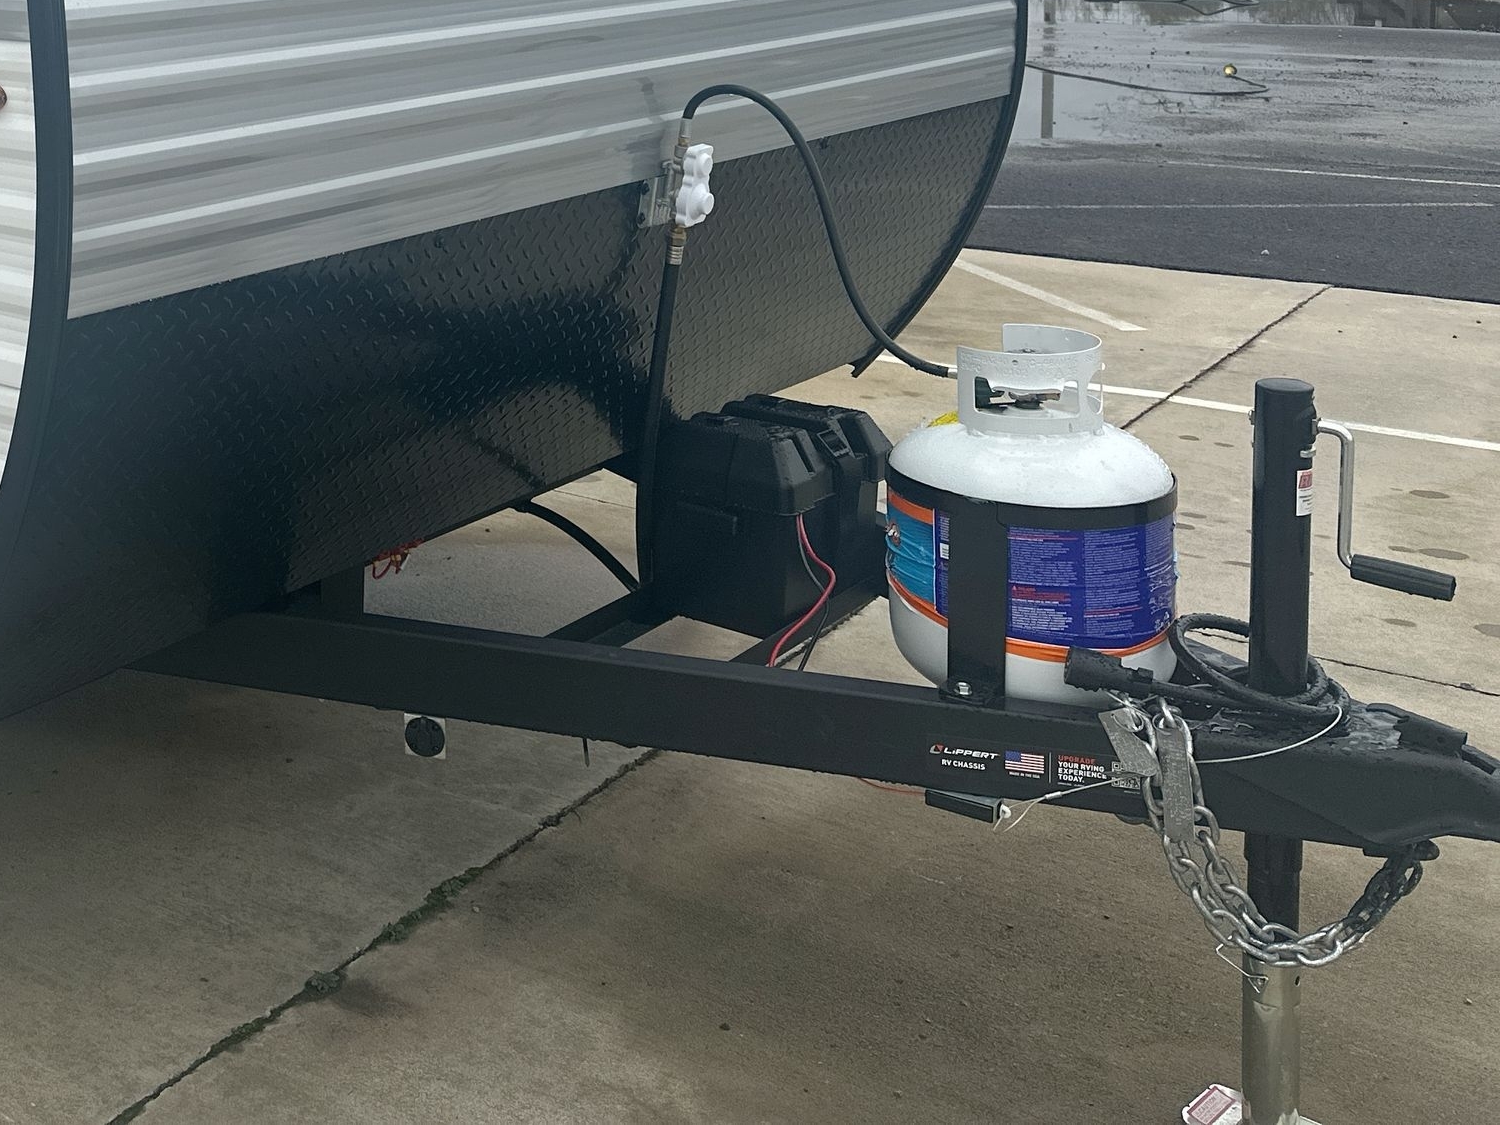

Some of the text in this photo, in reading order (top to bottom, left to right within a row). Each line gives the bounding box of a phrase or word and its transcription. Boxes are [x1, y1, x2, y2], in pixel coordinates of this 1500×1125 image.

[943, 747, 1000, 760] LIPPERT
[941, 759, 986, 771] RV CHASSIS
[1057, 755, 1096, 765] UPGRADE
[1057, 761, 1105, 773] YOUR RVING
[1057, 773, 1085, 783] TODAY.
